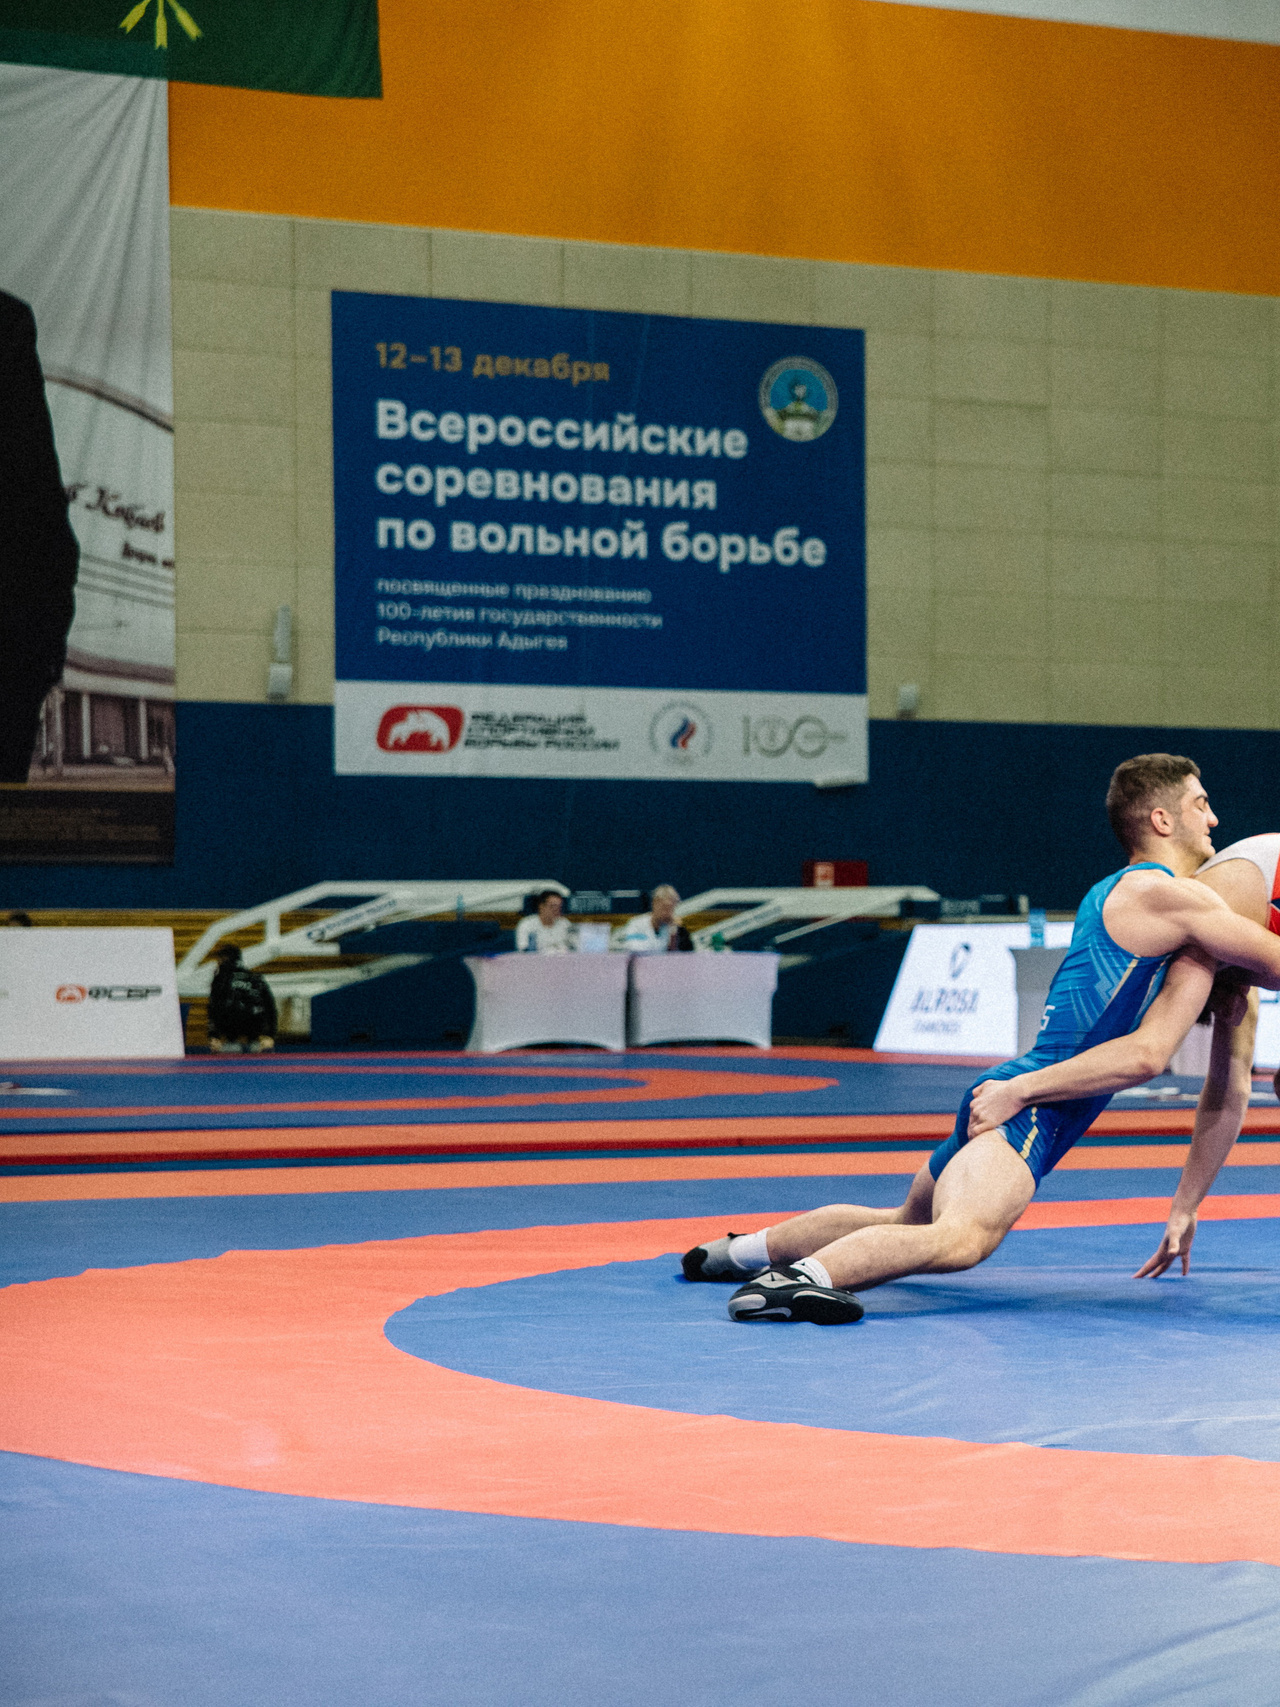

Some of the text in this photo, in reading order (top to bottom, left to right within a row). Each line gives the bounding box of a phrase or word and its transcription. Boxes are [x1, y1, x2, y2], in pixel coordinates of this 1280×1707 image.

[472, 352, 610, 387] декабря
[376, 398, 750, 460] Всероссийские
[376, 462, 718, 510] соревнования
[377, 517, 827, 574] по вольной борьбе
[377, 578, 653, 605] посвященные празднованию
[377, 601, 664, 629] 100-летия государственности
[377, 625, 493, 652] Республики
